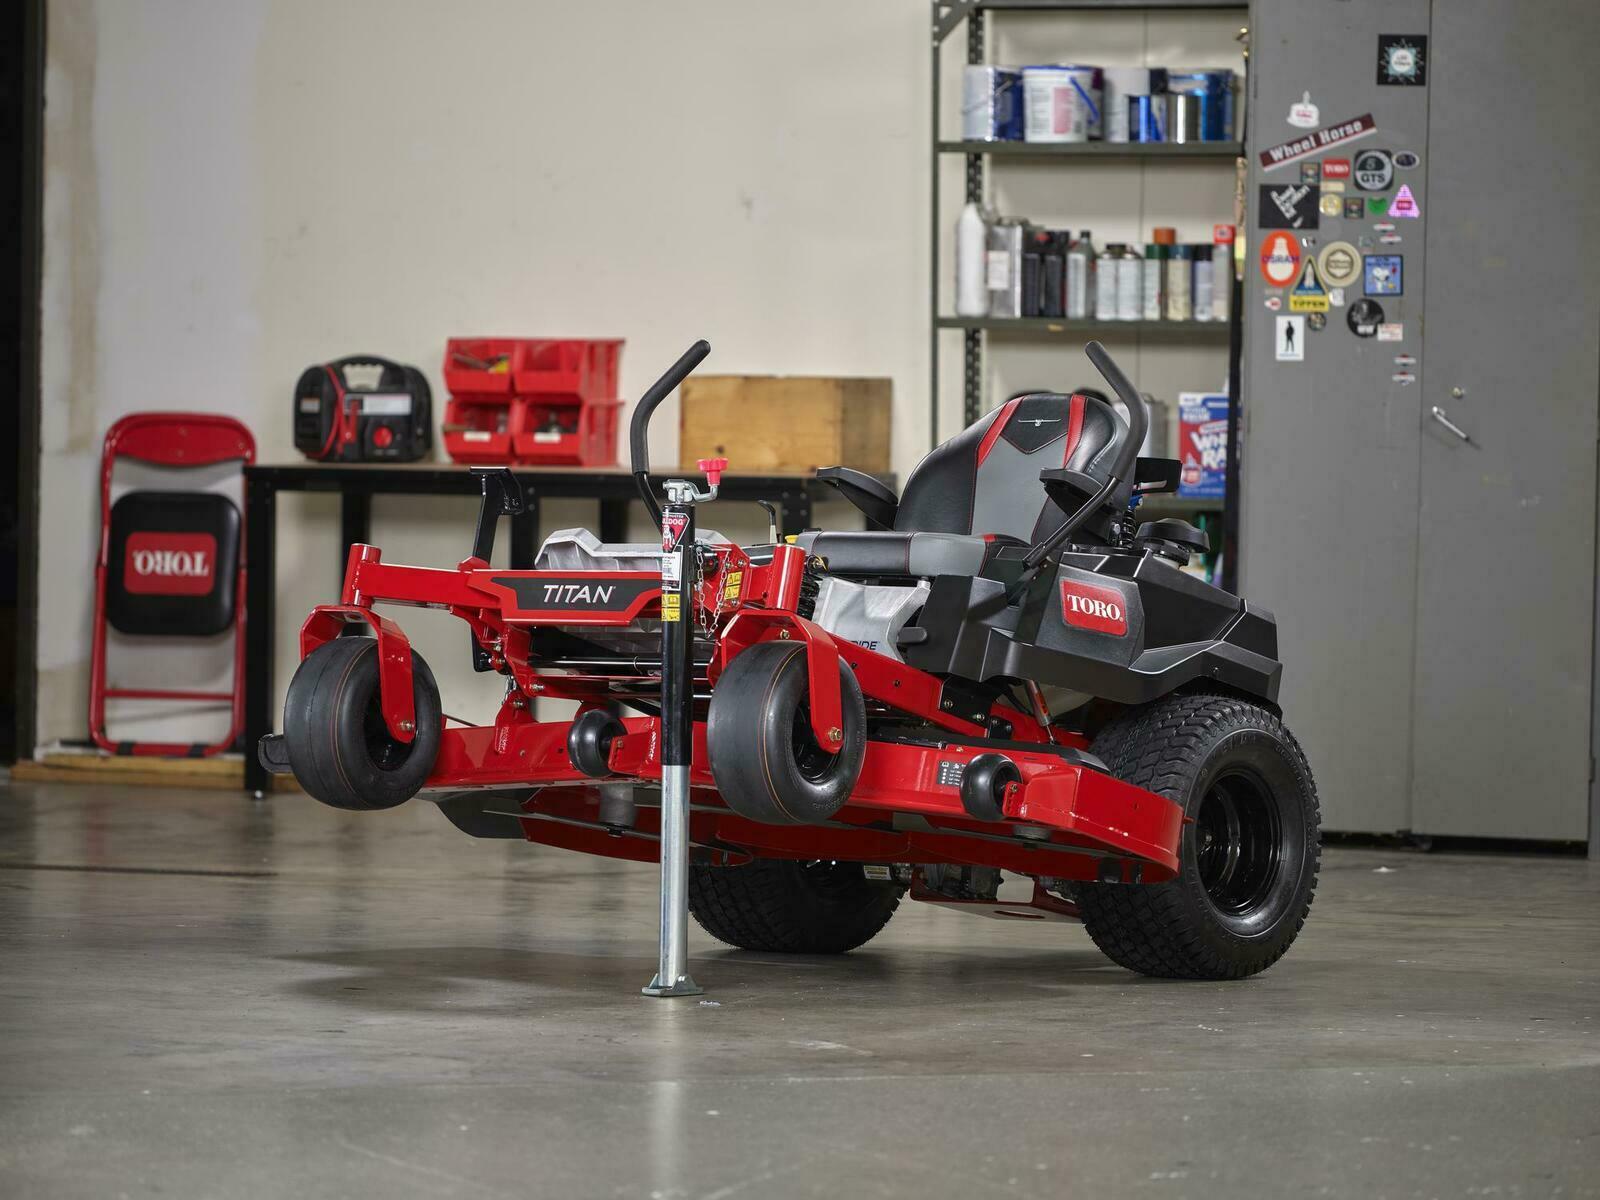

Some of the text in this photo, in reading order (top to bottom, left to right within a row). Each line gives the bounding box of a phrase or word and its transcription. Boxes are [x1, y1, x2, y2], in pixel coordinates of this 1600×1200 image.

[1269, 120, 1362, 161] Wheel Horse
[1361, 173, 1385, 183] GTS
[132, 551, 209, 576] TORO
[543, 585, 612, 604] TITAN
[1067, 594, 1121, 621] TORO
